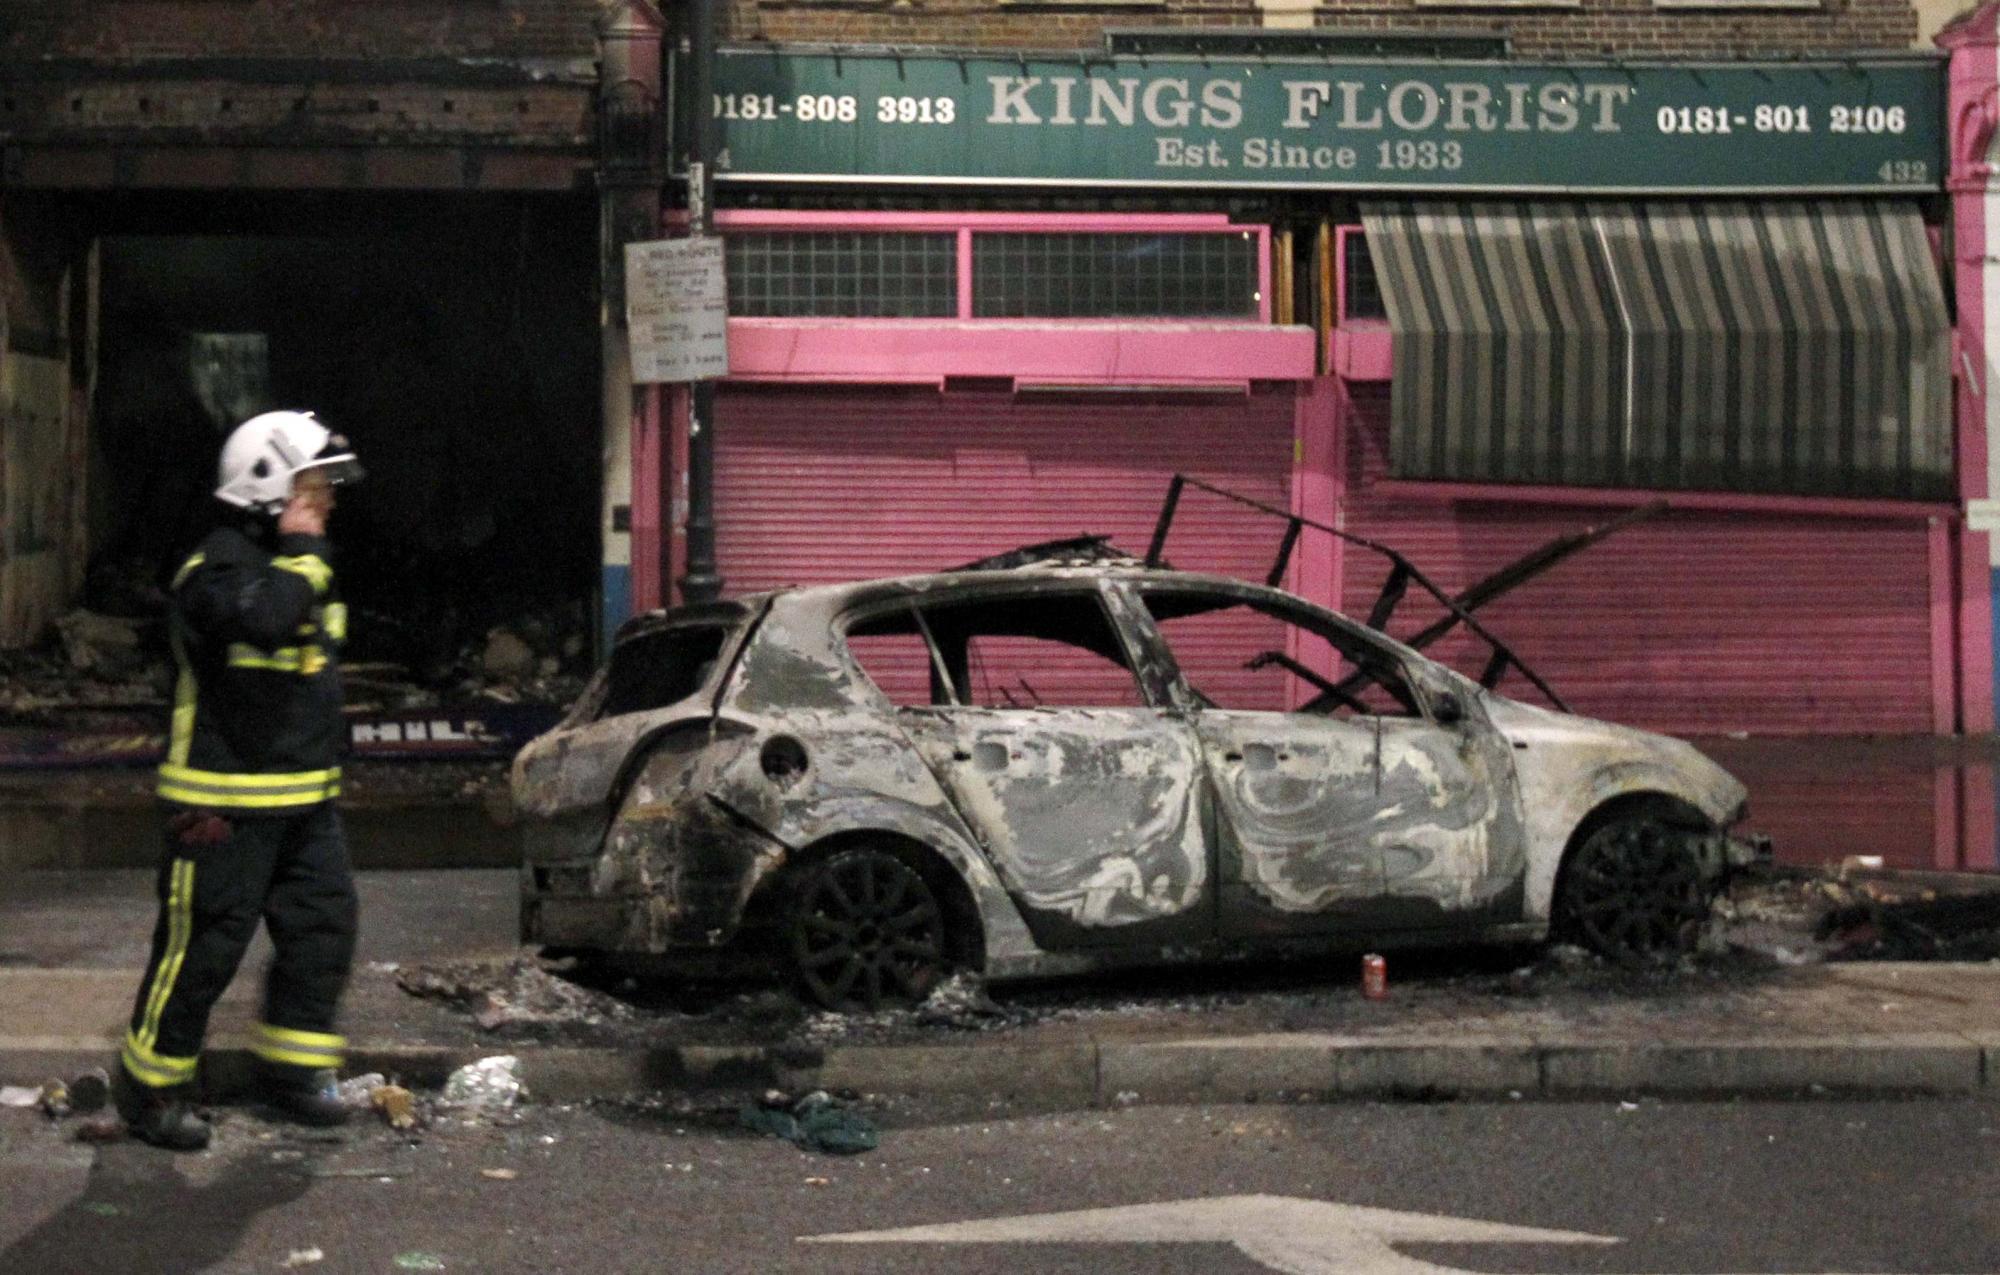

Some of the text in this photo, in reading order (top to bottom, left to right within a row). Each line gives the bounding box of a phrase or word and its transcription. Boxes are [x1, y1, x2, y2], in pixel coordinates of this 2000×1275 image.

[877, 96, 956, 124] 3913
[986, 75, 1630, 133] KINGS FLORIST
[1829, 105, 1907, 134] 2106
[1155, 137, 1463, 170] Est. Since 1933
[1877, 160, 1928, 184] 432
